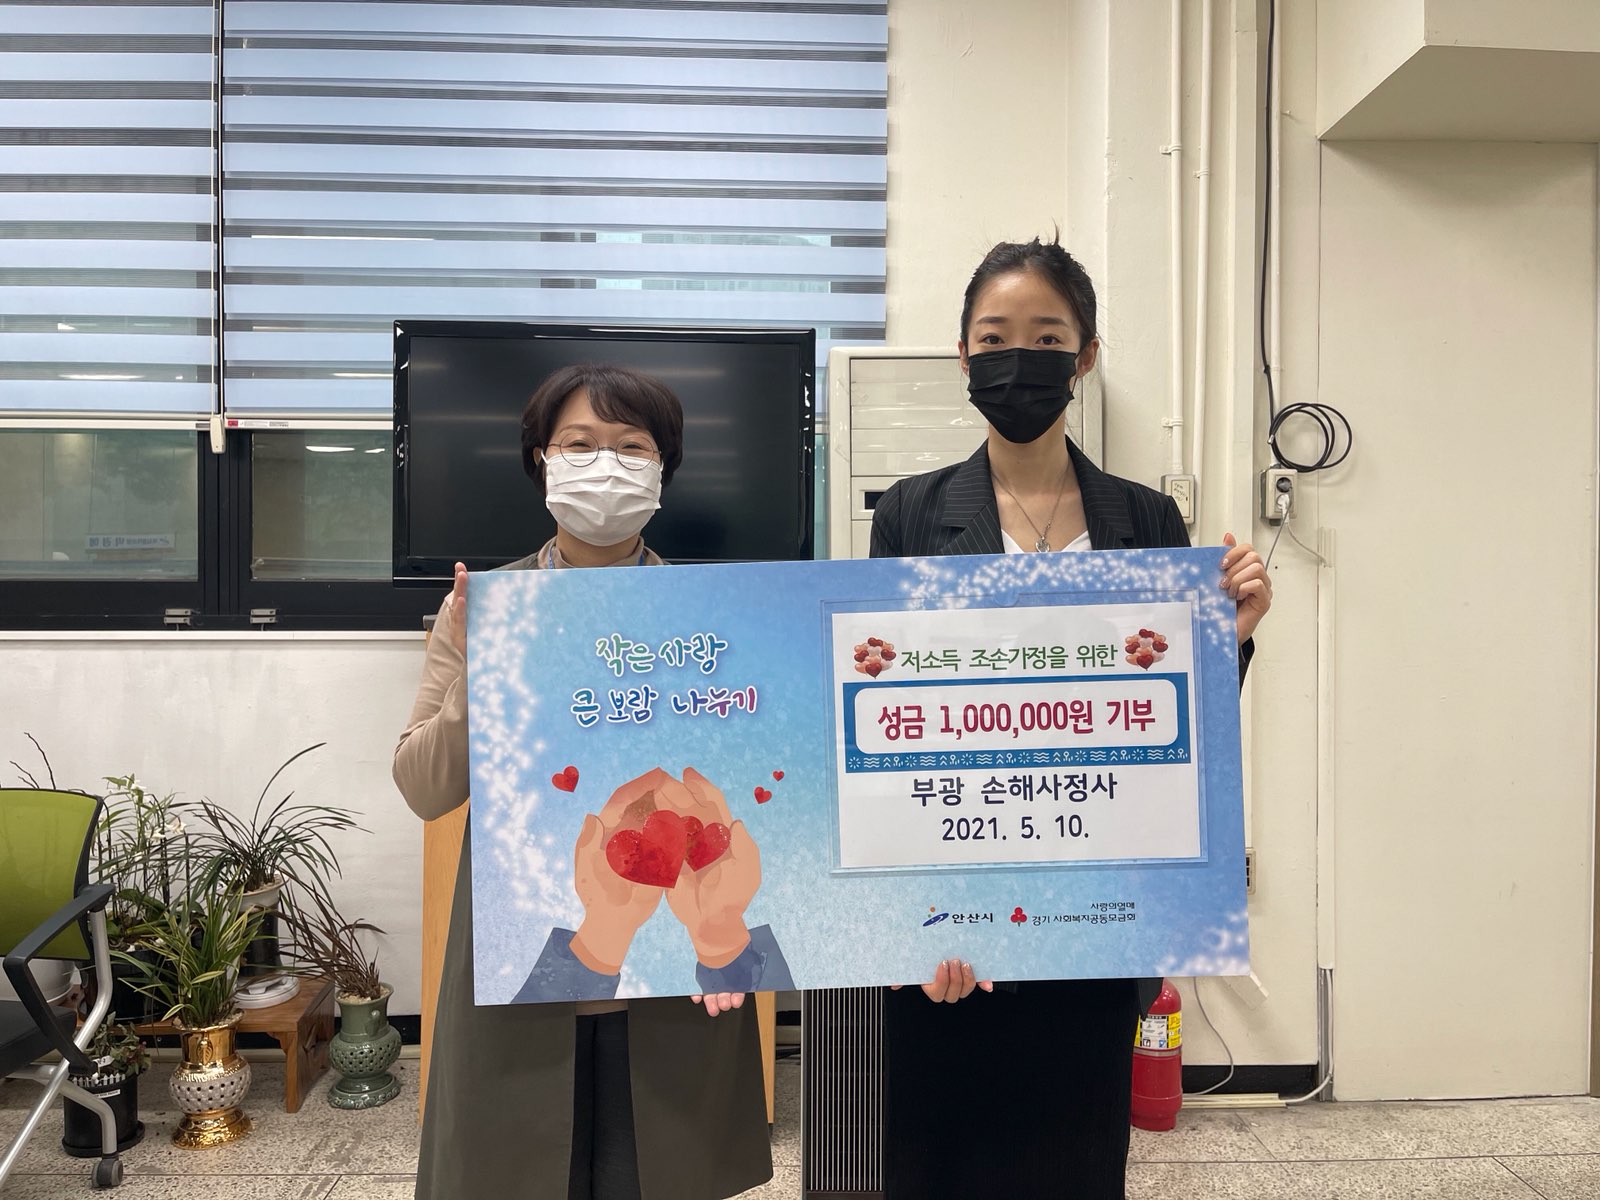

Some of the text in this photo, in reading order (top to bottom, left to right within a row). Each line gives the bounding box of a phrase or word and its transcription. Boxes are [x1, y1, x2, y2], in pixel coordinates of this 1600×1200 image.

[596, 632, 728, 676] 작은 사랑
[900, 644, 1118, 673] 저소득 조손가정을 위한
[571, 684, 757, 728] 큰 보람 나누기
[877, 699, 1155, 741] 성금 1,000,000원 기부
[910, 772, 1118, 807] 부광 손해사정사
[941, 814, 1089, 841] 2021. 5. 10.
[951, 913, 993, 924] 안산시
[1032, 913, 1136, 926] 경기 사회복지공동모금회
